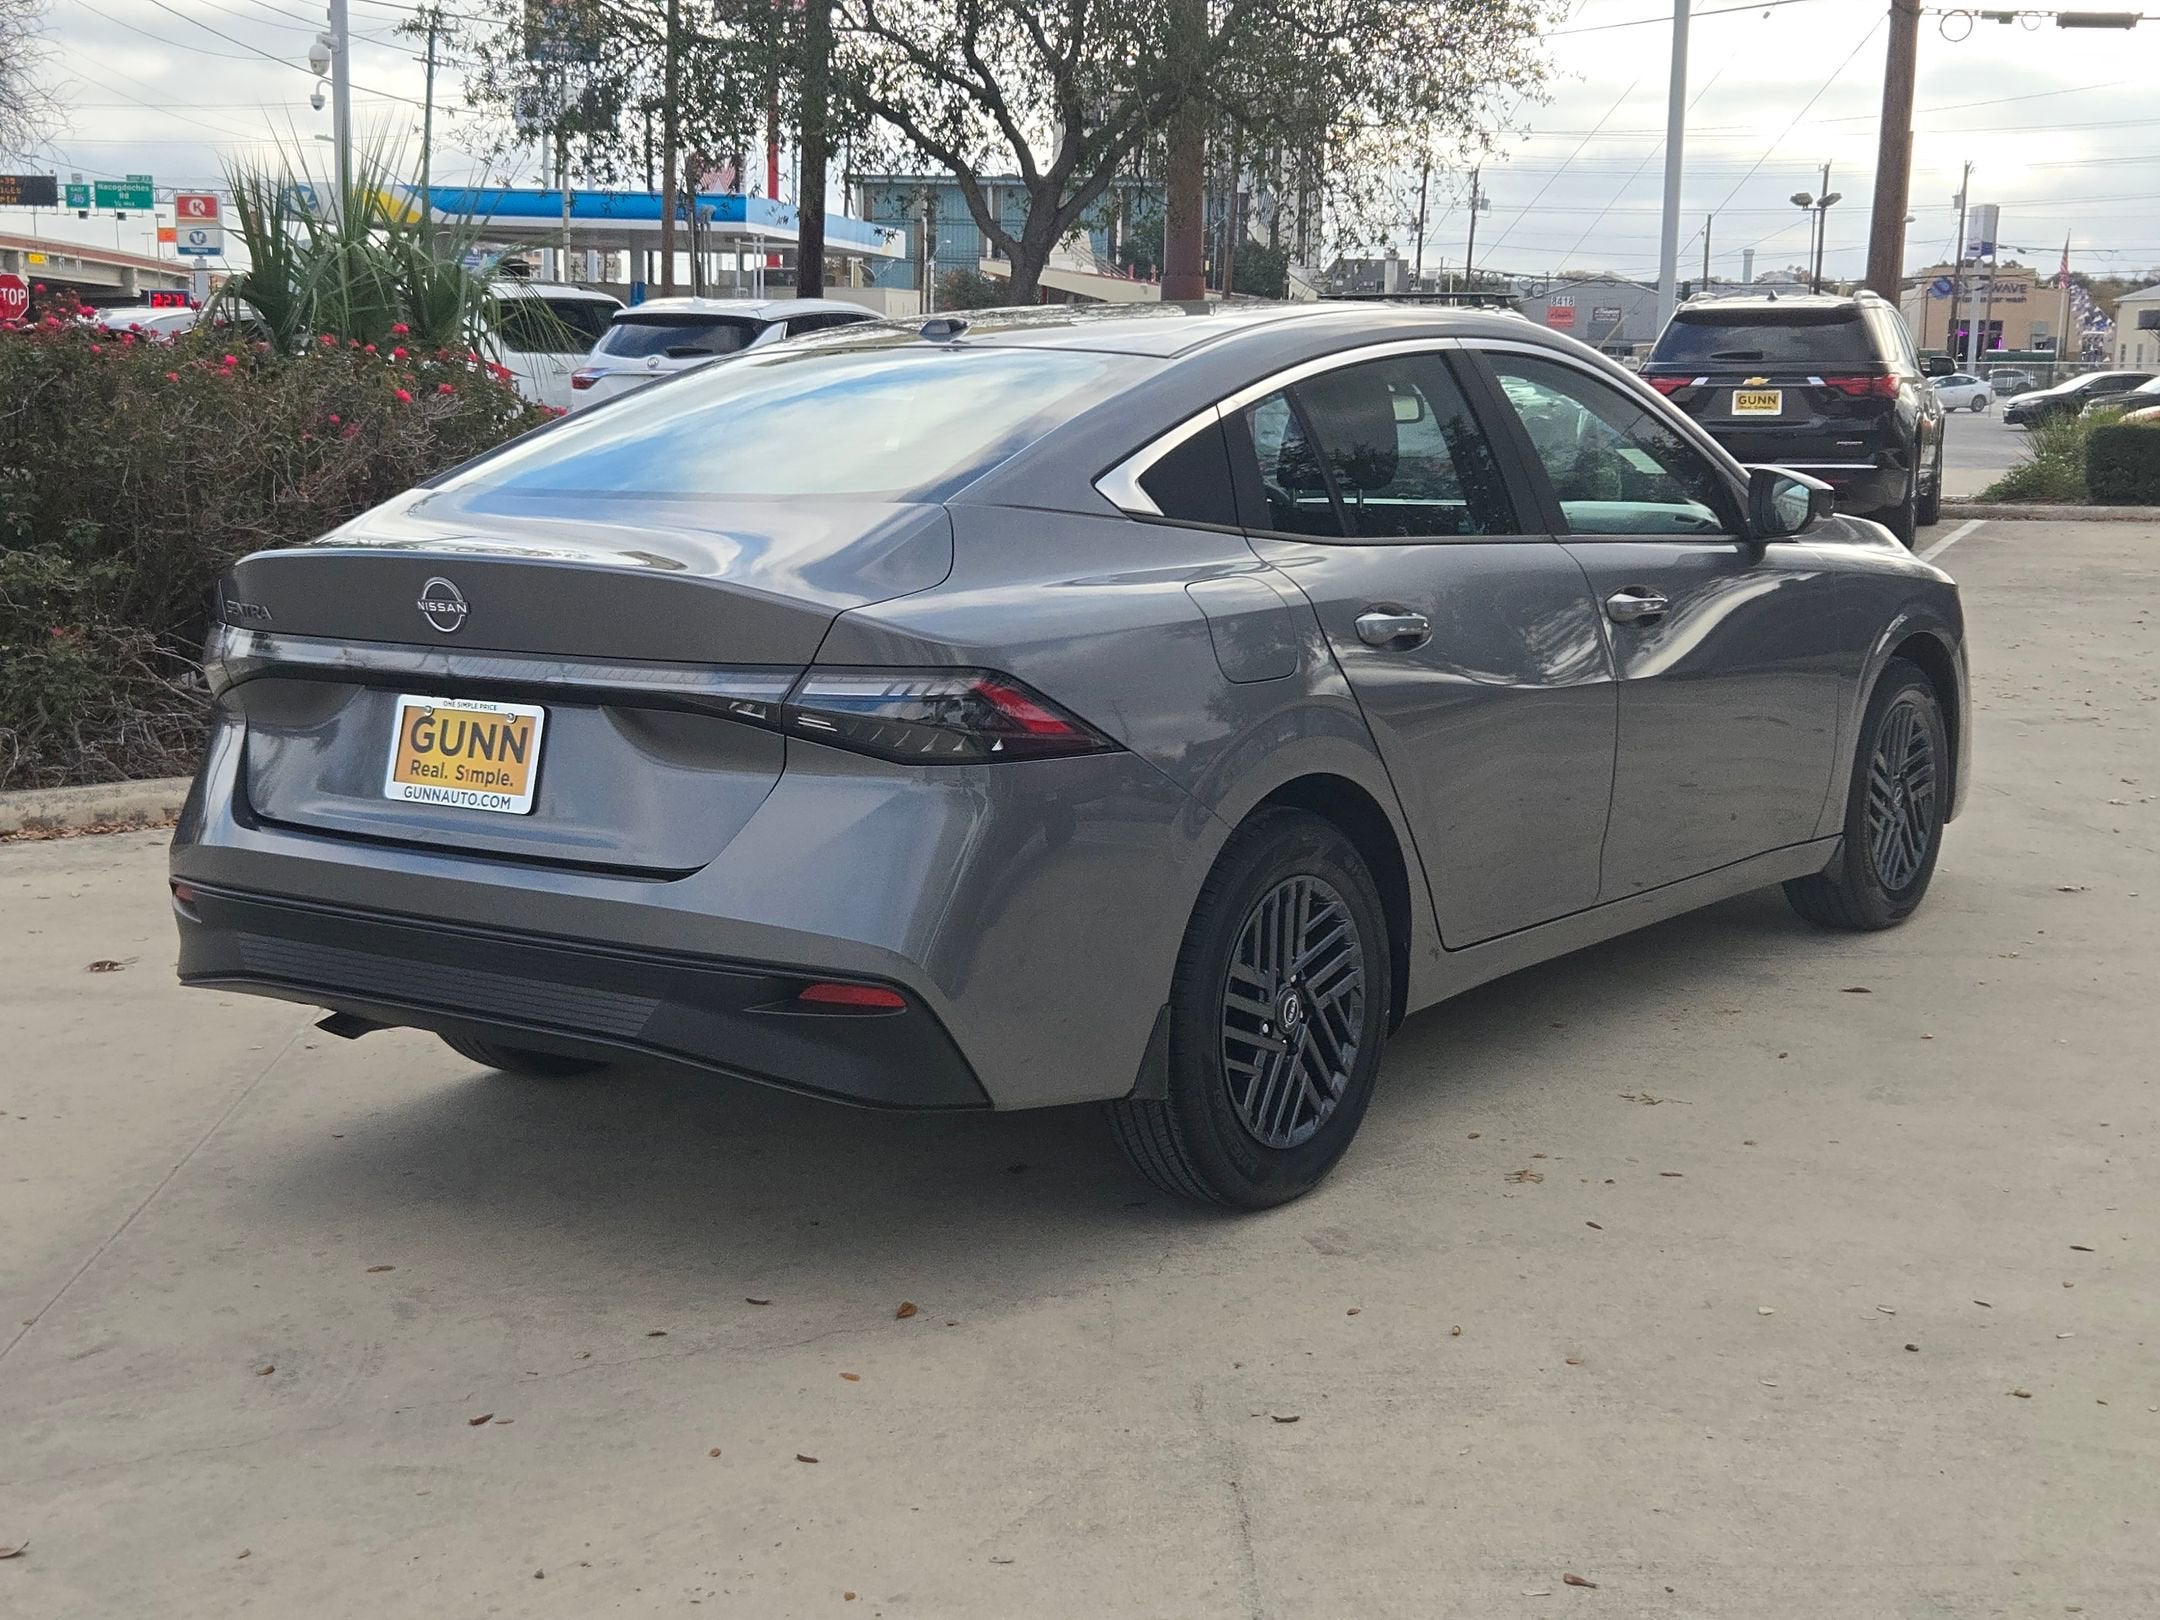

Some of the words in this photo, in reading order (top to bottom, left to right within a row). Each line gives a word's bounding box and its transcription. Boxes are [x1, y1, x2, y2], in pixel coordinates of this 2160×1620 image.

[97, 184, 149, 192] Nacogdoches
[0, 287, 26, 306] TOP
[1551, 296, 1574, 306] 8418
[1738, 395, 1777, 405] GUNN
[417, 600, 467, 613] NISSAN
[457, 701, 479, 710] SIMPLE
[480, 703, 497, 711] PRICE
[410, 715, 529, 764] GUNN
[410, 759, 448, 780] Real.
[404, 785, 511, 810] GUNNAUTO.COM
